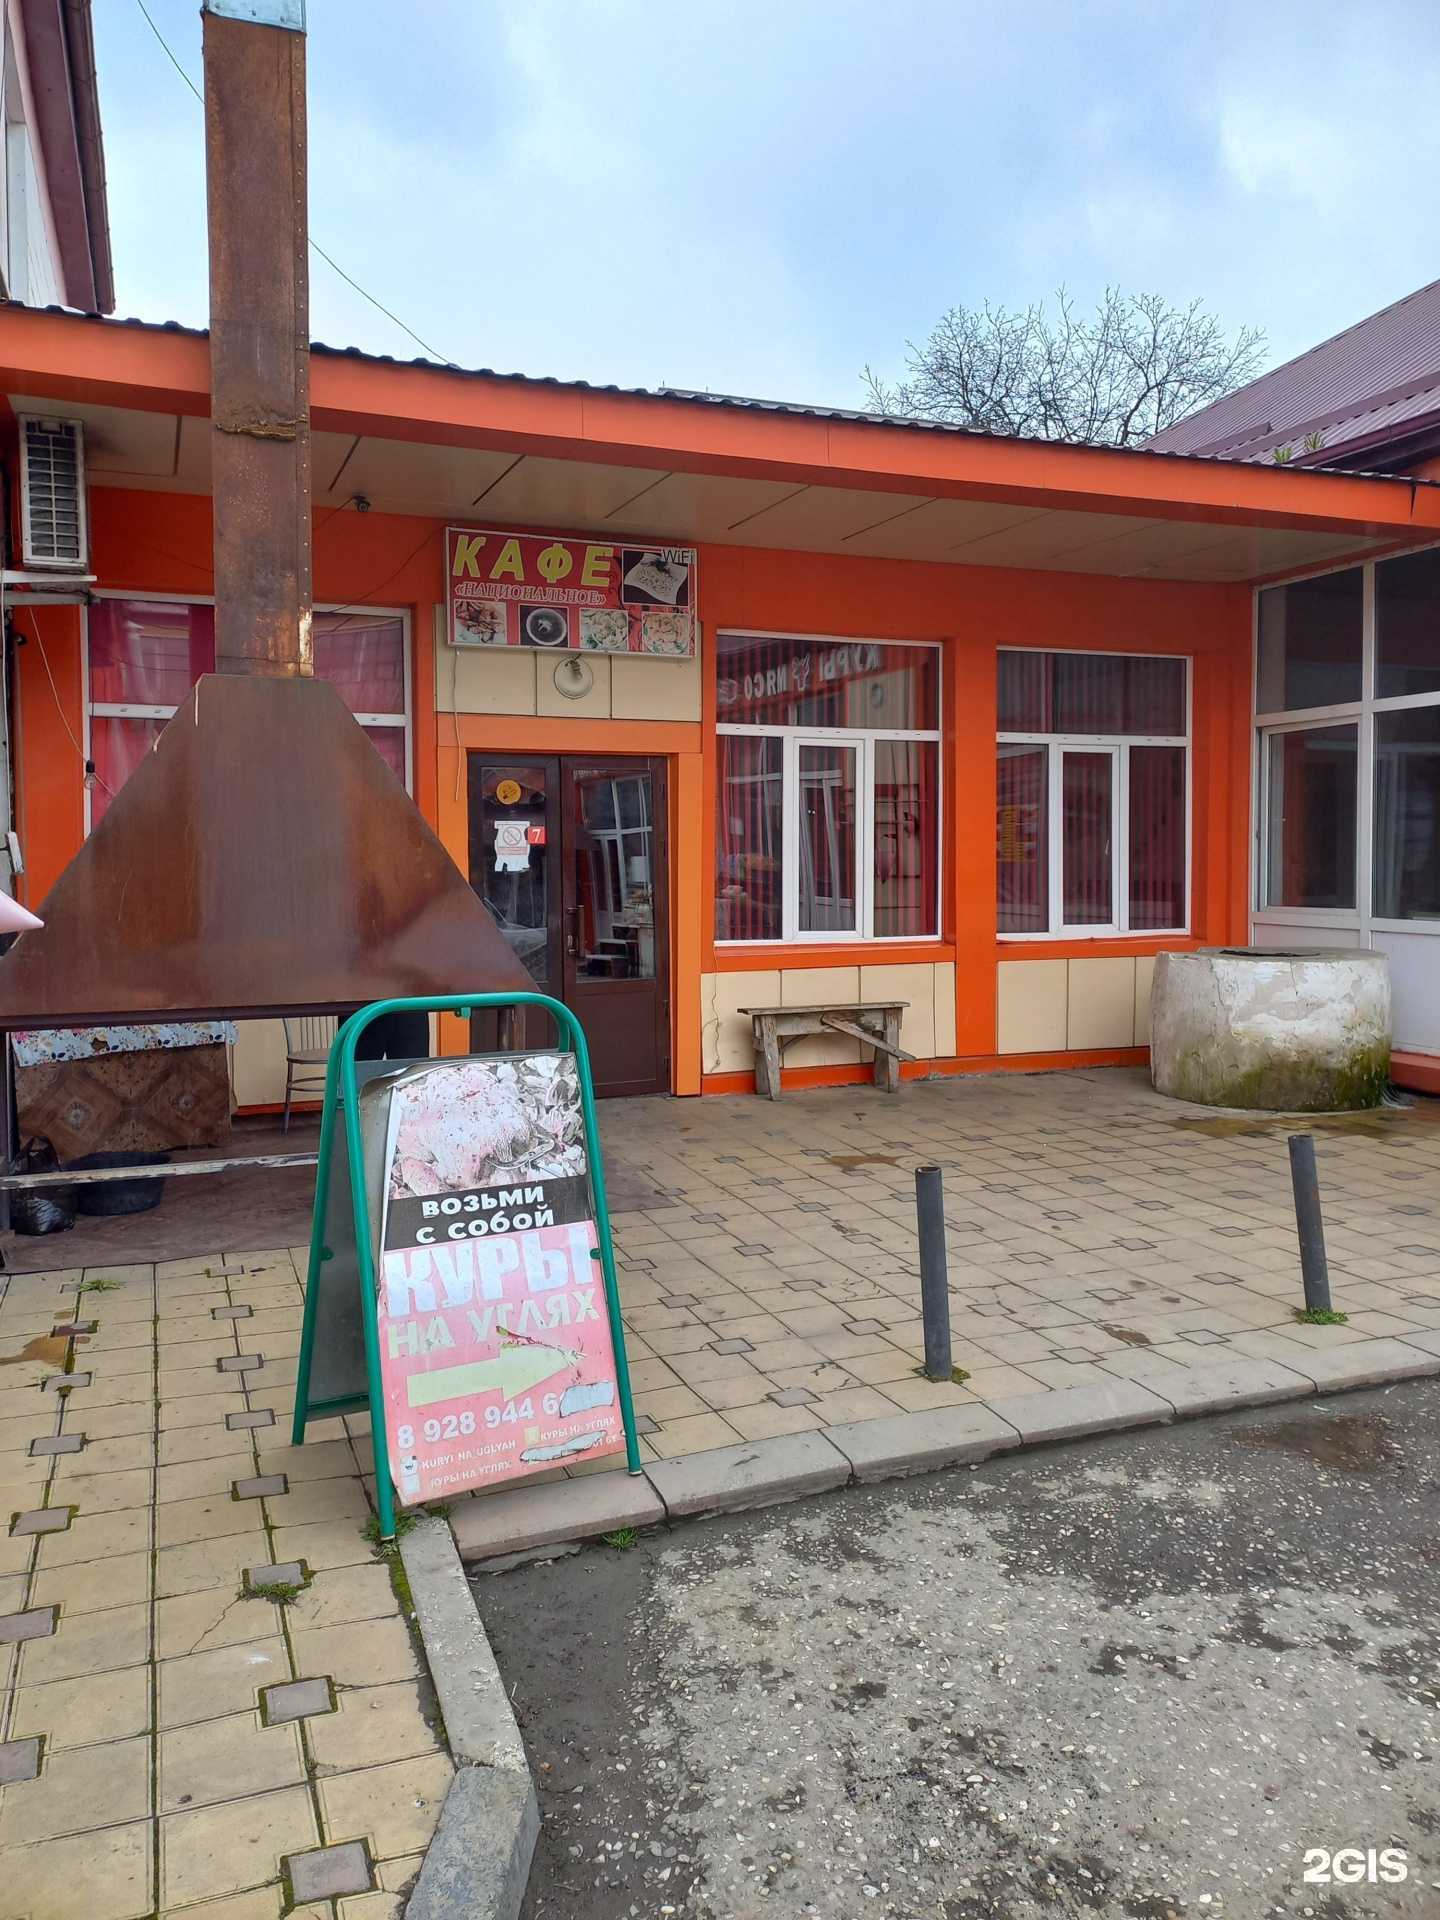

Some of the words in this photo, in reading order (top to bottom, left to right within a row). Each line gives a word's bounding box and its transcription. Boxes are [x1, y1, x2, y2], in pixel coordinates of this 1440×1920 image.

[452, 535, 614, 587] КАФЕ
[532, 829, 541, 842] 7
[384, 1225, 594, 1318] КУРЫ
[388, 1317, 456, 1360] НА
[467, 1288, 600, 1344] УГЛЯХ
[397, 1424, 415, 1449] 8
[424, 1410, 475, 1443] 928
[485, 1397, 535, 1429] 944
[542, 1392, 565, 1415] 6
[541, 1428, 568, 1440] КУРЫ
